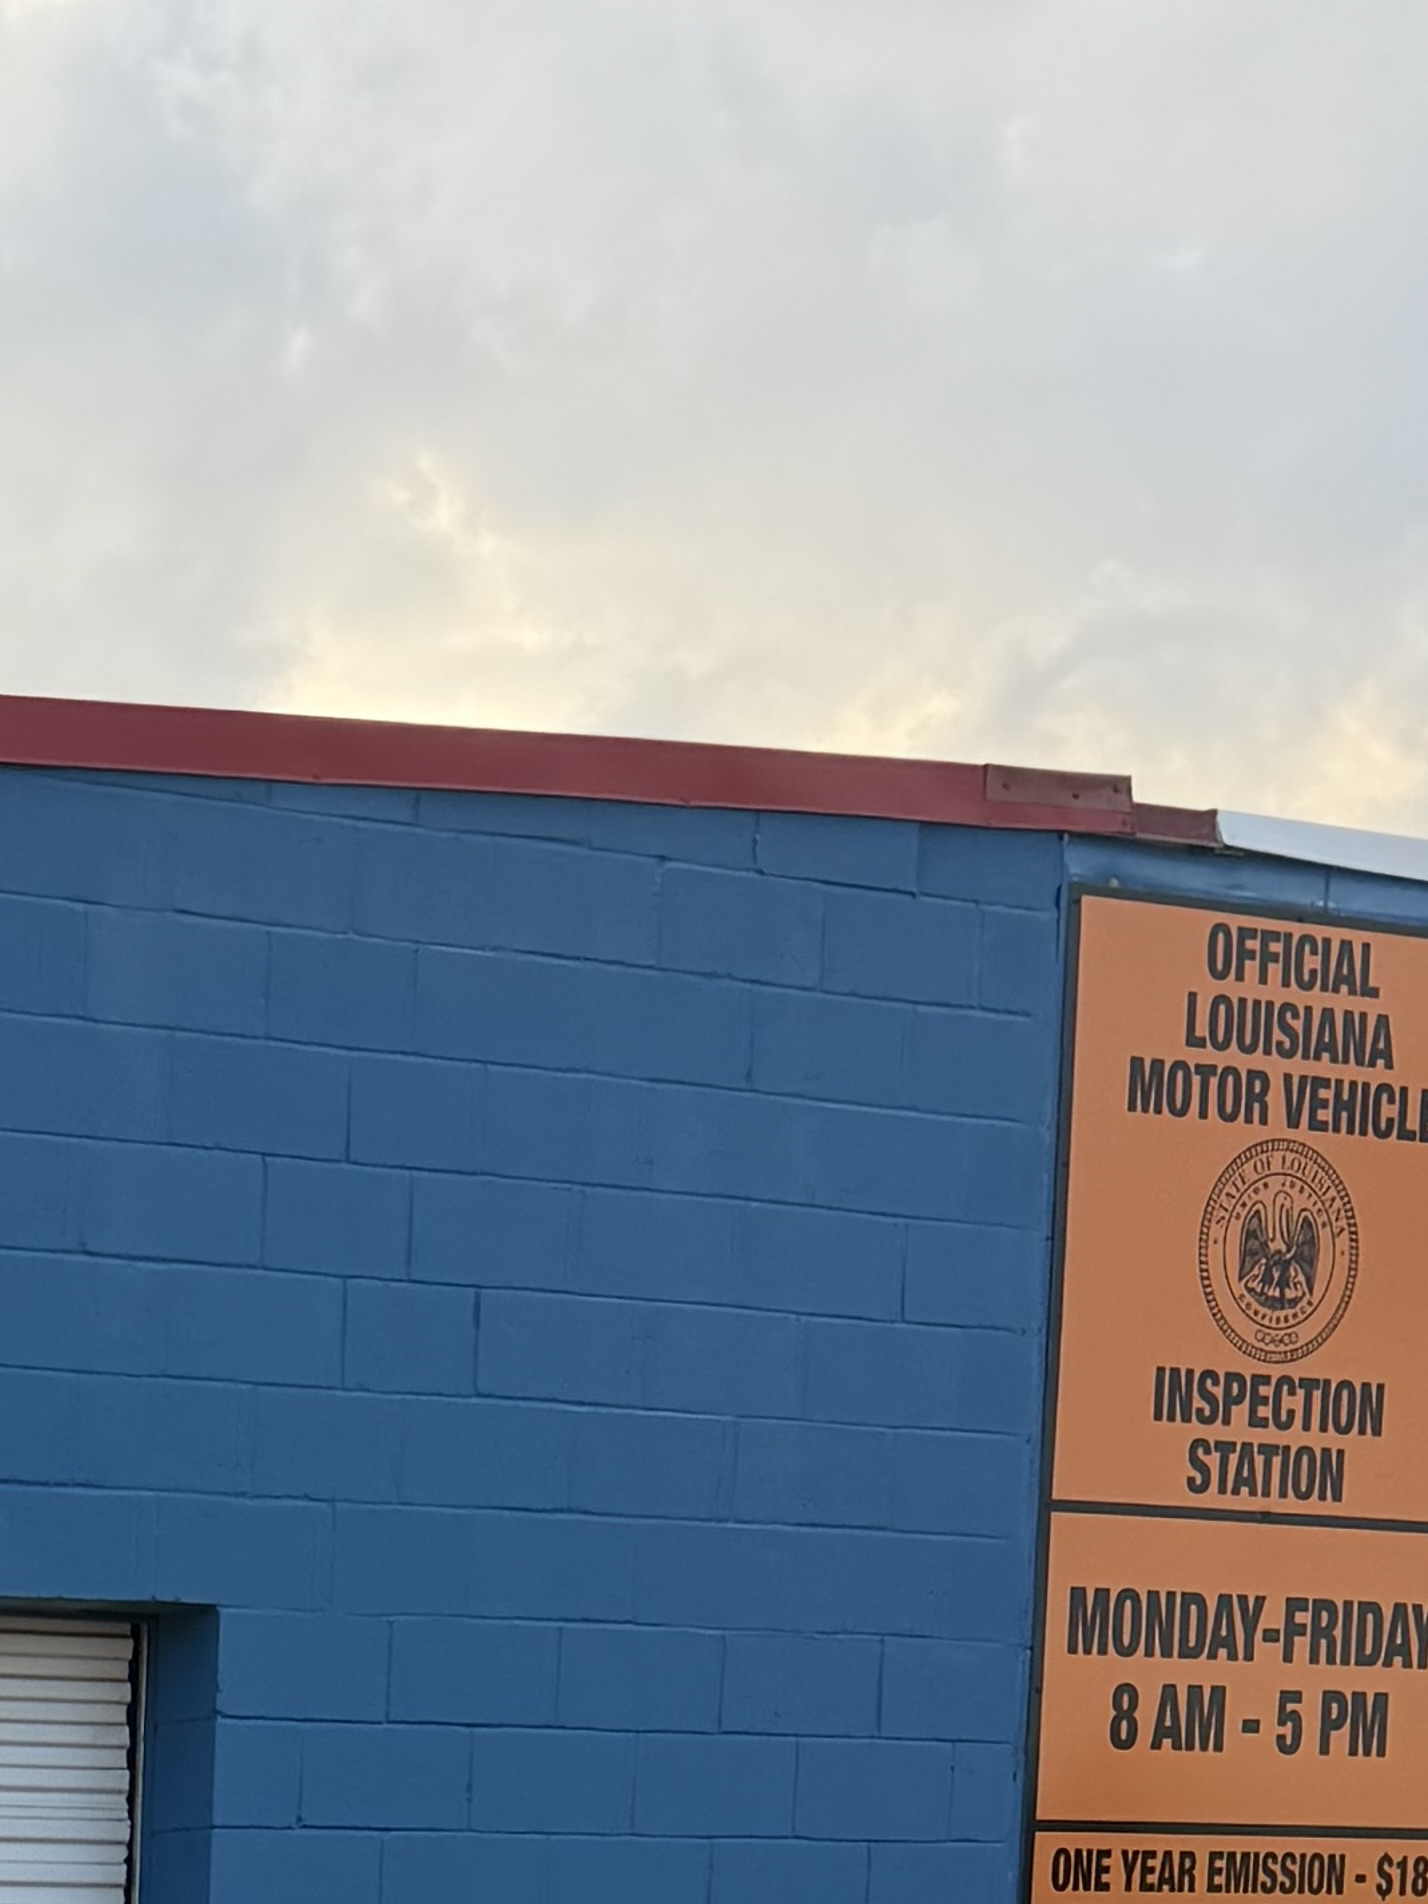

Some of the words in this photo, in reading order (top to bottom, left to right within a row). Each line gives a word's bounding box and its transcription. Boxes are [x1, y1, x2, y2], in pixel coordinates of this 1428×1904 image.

[1208, 923, 1379, 998] OFFICIAL
[1186, 992, 1393, 1070] LOUISIANA
[1128, 1056, 1270, 1126] MOTOR
[1214, 1171, 1249, 1230] STATE
[1253, 1154, 1274, 1176] OF
[1280, 1154, 1348, 1240] LOUISIANA
[1154, 1366, 1384, 1437] INSPECTION
[1187, 1438, 1344, 1502] STATION
[1067, 1586, 1428, 1669] MONDAY-FRIDAY
[1110, 1683, 1138, 1750] 8
[1150, 1684, 1226, 1752] AM
[1242, 1719, 1260, 1733] -
[1276, 1690, 1302, 1755] 5
[1319, 1690, 1388, 1757] PM
[1051, 1848, 1112, 1892] ONE
[1121, 1849, 1196, 1893] YEAR
[1206, 1851, 1345, 1895] EMISSION
[1376, 1852, 1428, 1901] $18
